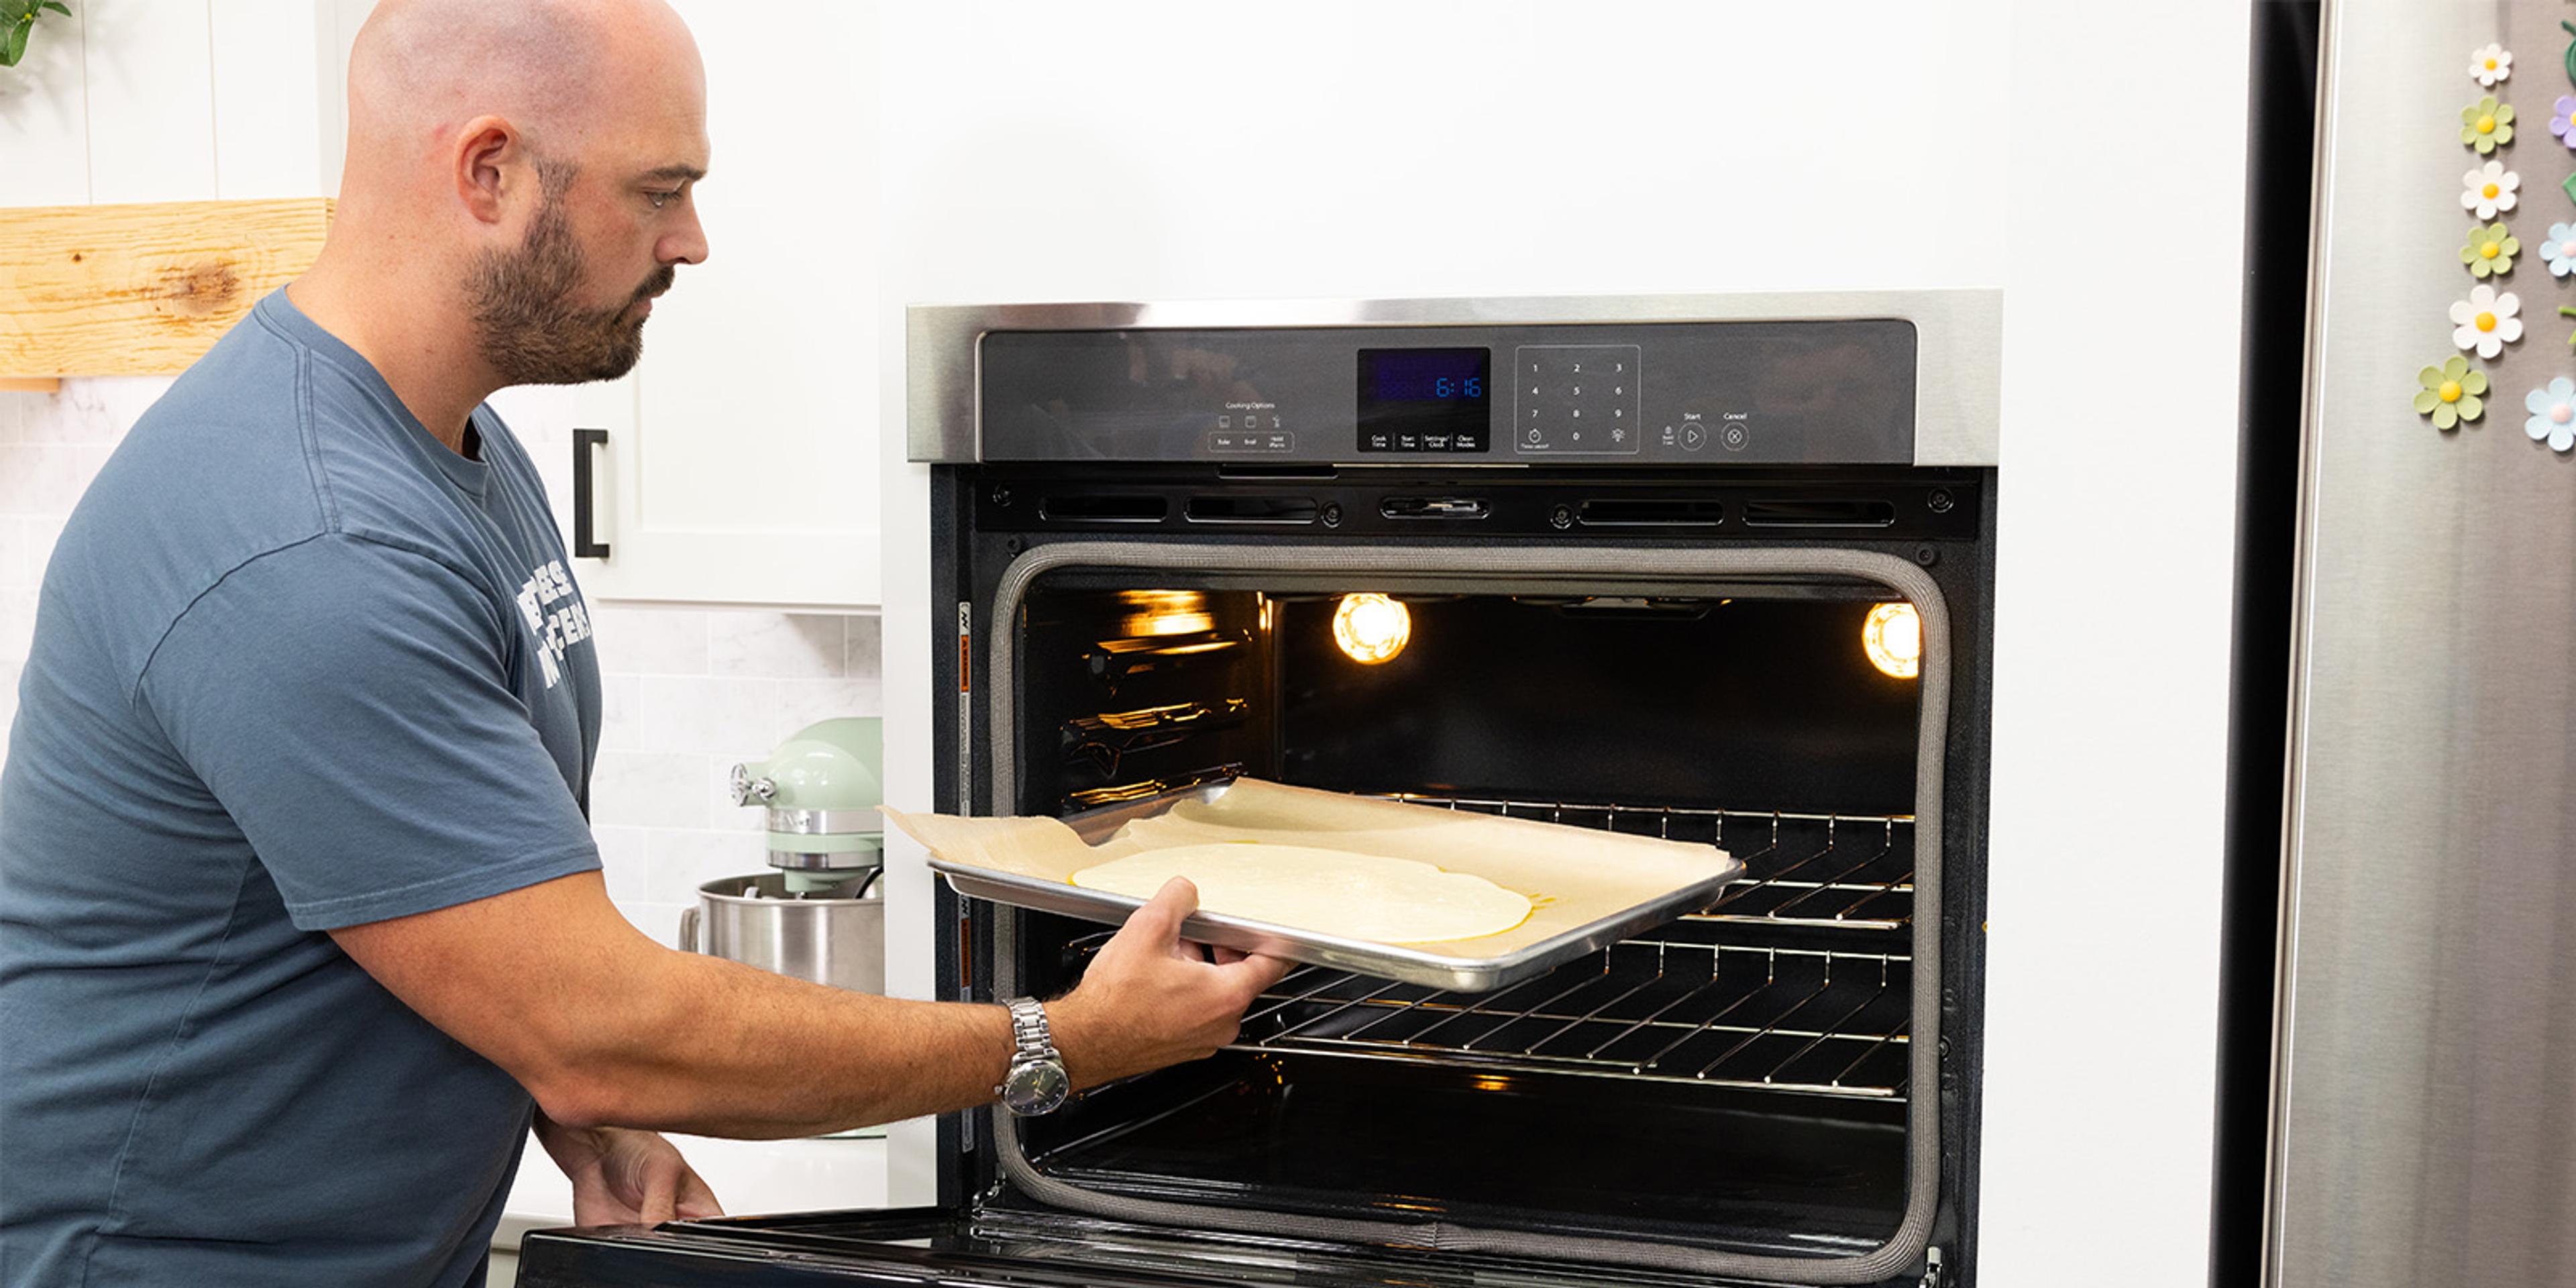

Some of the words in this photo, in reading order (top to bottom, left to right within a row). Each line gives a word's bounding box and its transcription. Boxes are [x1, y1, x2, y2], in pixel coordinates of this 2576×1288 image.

[1533, 364, 1538, 372] 1
[1574, 364, 1580, 372] 2
[1616, 364, 1622, 372] 3
[1436, 377, 1481, 397] 6:16
[1532, 386, 1538, 394] 4
[1573, 386, 1580, 395] 5
[1615, 386, 1622, 394] 6
[1225, 402, 1250, 410] Cooking
[1250, 402, 1275, 410] Options
[1532, 409, 1538, 417] 7
[1573, 409, 1580, 417] 8
[1615, 409, 1622, 417] 9
[1573, 431, 1580, 440] 0
